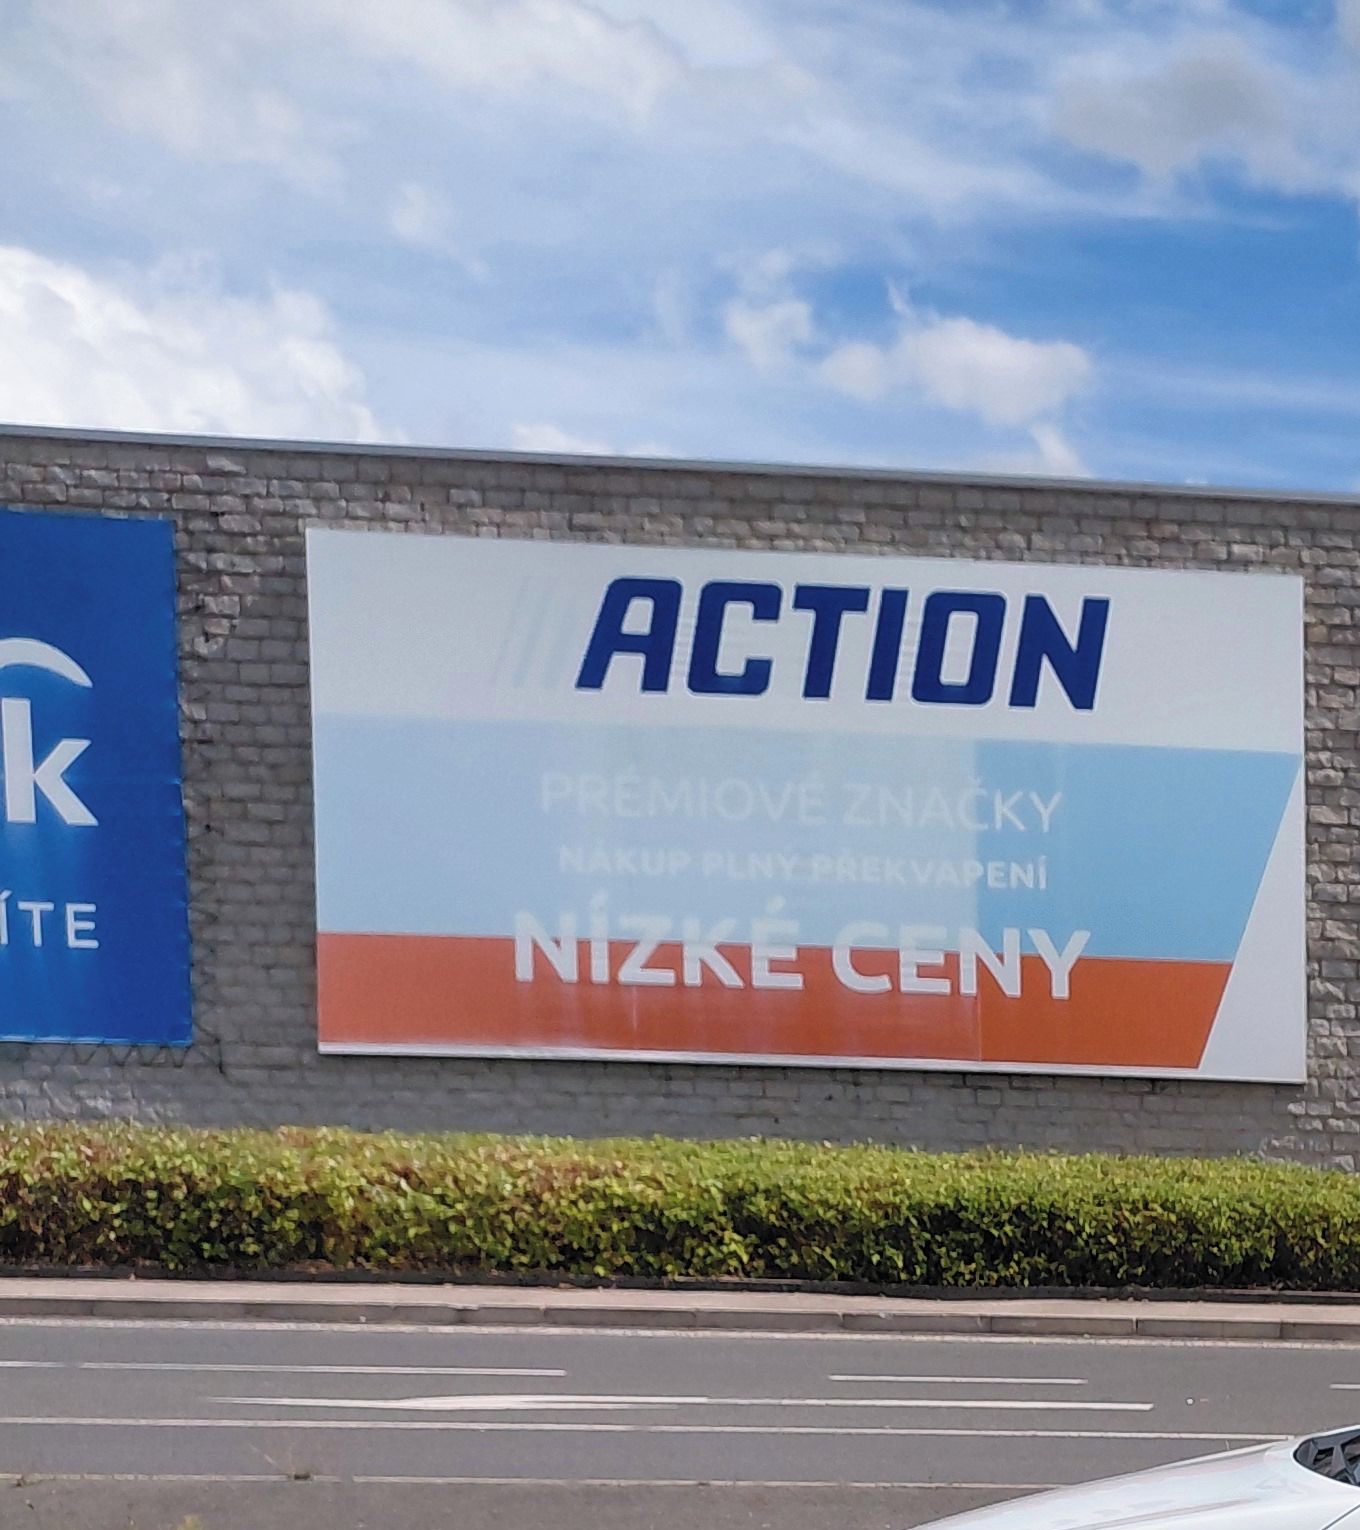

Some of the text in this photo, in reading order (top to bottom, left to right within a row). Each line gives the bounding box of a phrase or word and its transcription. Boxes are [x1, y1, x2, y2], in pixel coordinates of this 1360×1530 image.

[576, 577, 1111, 711] ACTION
[540, 764, 1063, 834] PRÉMIOVÉ ZNAČKY
[513, 893, 1092, 1000] NÍZKÉ CENY
